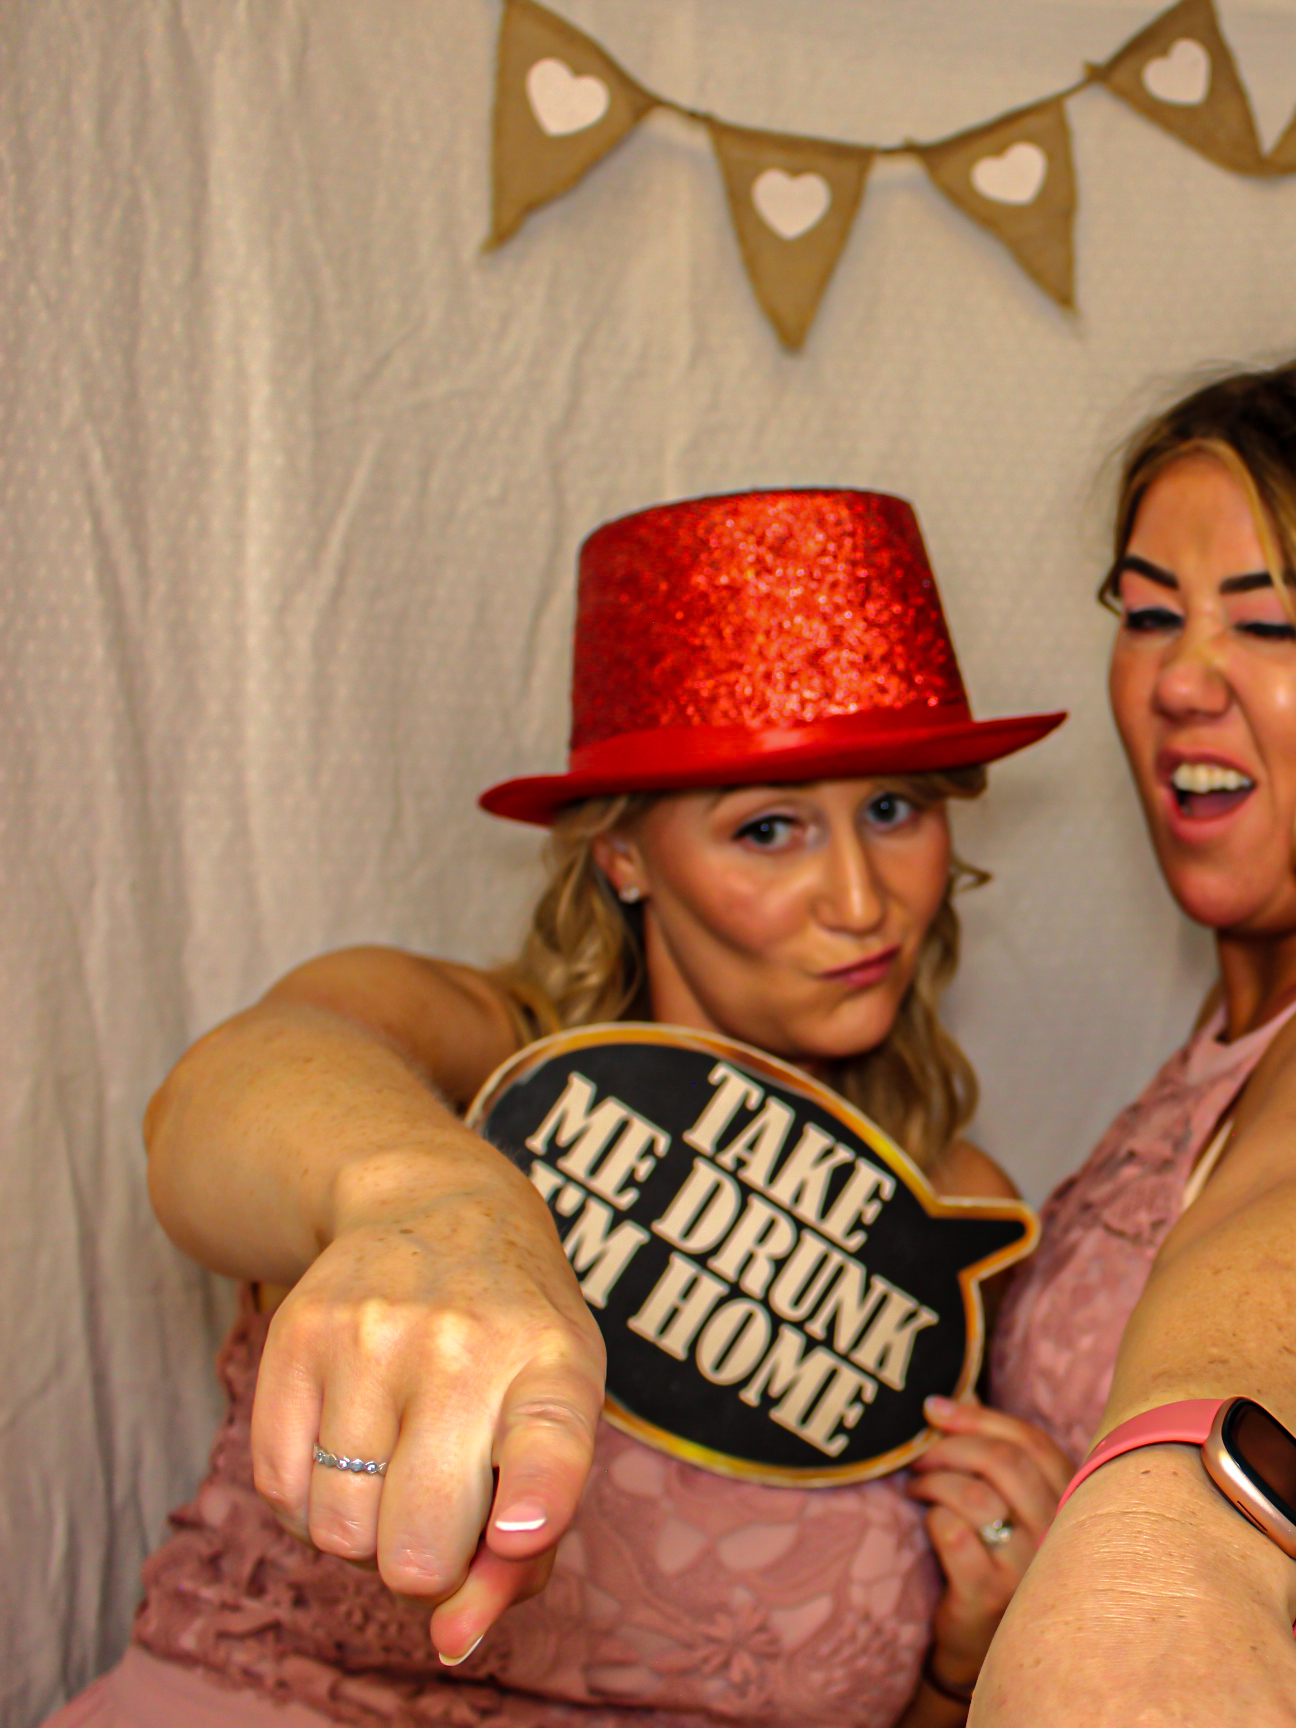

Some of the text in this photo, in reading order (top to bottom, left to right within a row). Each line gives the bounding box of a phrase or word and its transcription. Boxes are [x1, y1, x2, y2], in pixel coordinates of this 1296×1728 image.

[525, 1072, 939, 1390] ME DRUNK
[683, 1062, 896, 1252] TAKE
[628, 1252, 878, 1457] HOME
